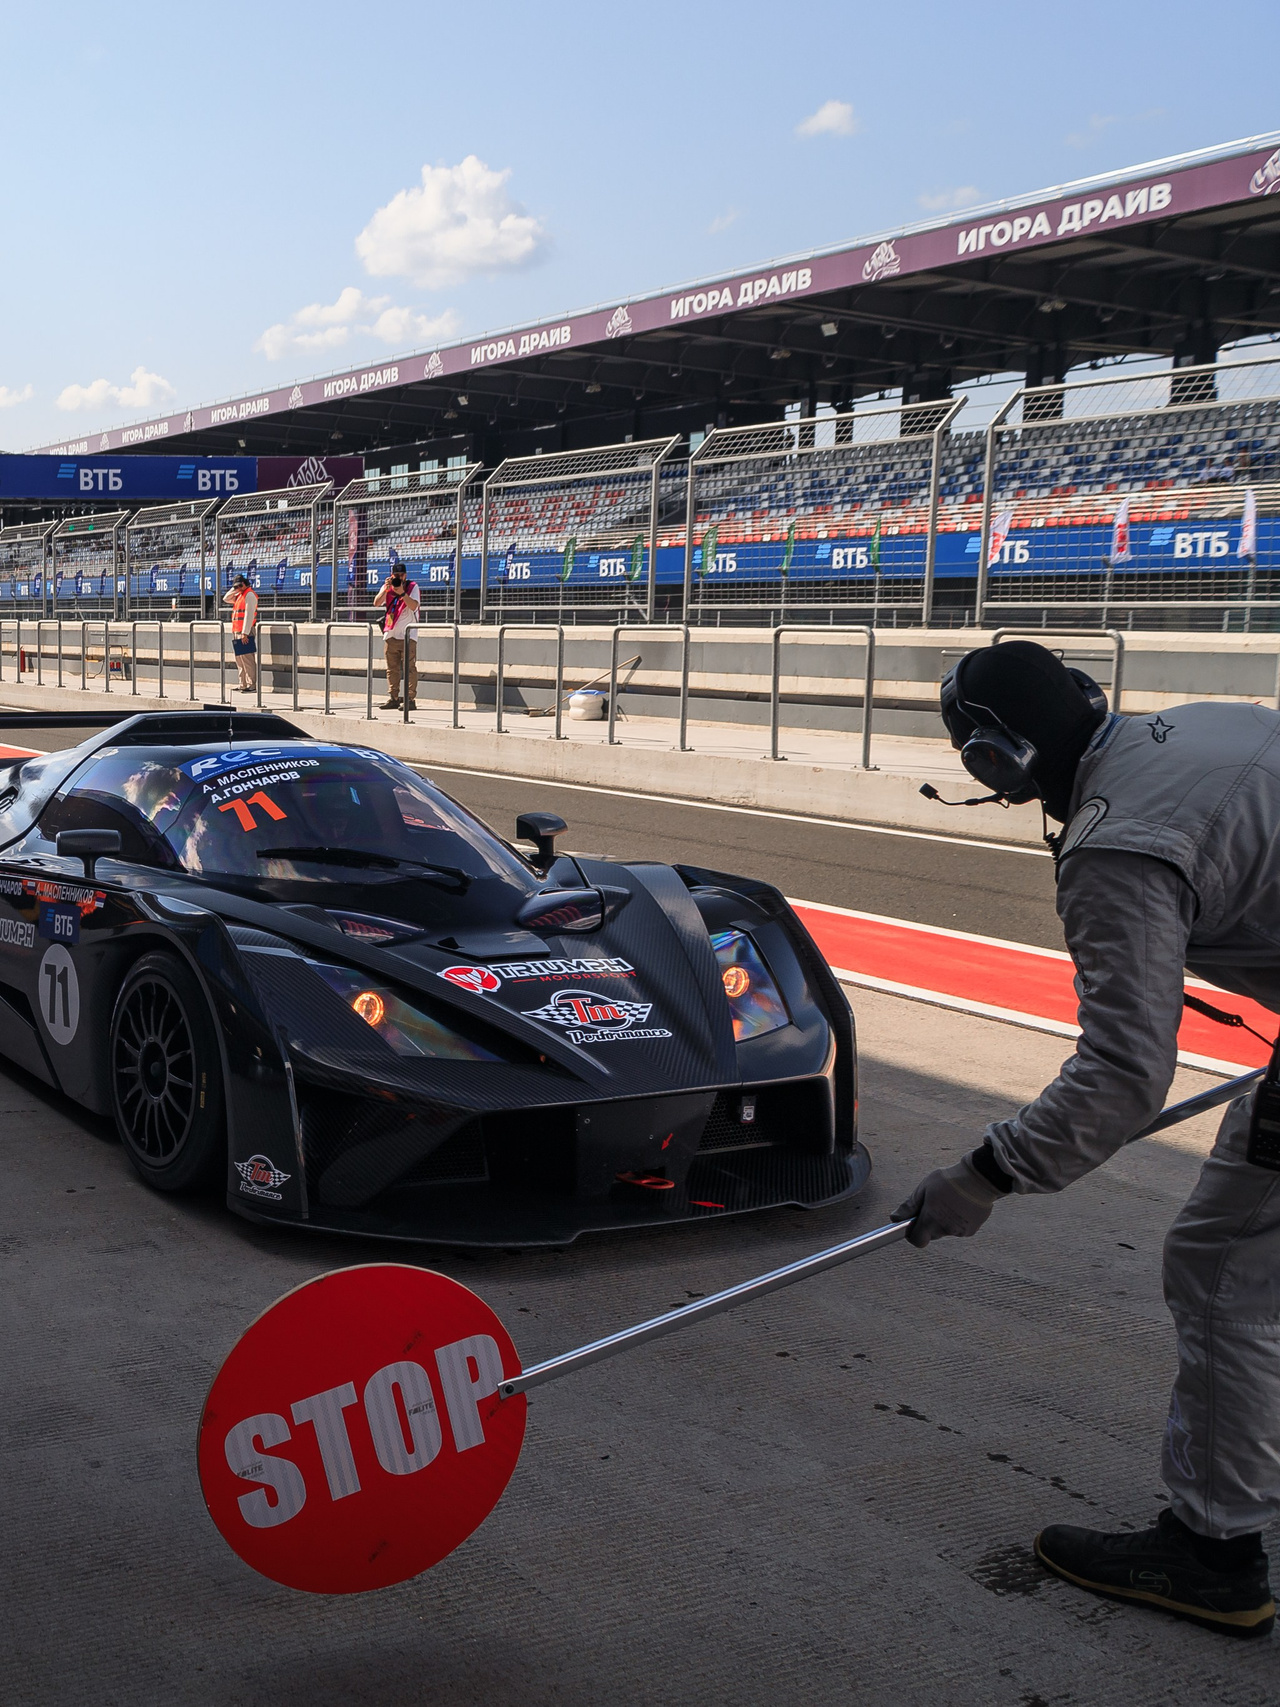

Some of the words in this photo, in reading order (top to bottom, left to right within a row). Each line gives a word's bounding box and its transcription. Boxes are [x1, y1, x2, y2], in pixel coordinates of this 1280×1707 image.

[957, 212, 1052, 256] ИГОРА
[1056, 182, 1172, 236] ДРАЙВ
[670, 290, 734, 320] ИГОРА
[736, 268, 812, 307] ДРАЙВ
[471, 339, 516, 364] ИГОРА
[518, 325, 571, 355] ДРАЙВ
[324, 376, 358, 398] ИГОРА
[360, 366, 399, 391] ДРАЙВ
[211, 406, 239, 423] ИГОРА
[122, 426, 143, 443] ИГОРА
[79, 469, 123, 491] ВТБ
[197, 469, 239, 491] ВТБ
[1173, 531, 1229, 558] ВТБ
[599, 558, 626, 577] ВТБ
[831, 547, 869, 569] ВТБ
[367, 569, 379, 584] ТБ
[430, 566, 450, 582] ВТБ
[508, 562, 531, 580] ВТБ
[156, 579, 168, 591] ВТБ
[202, 784, 216, 794] А.
[217, 759, 320, 787] МАСЛЕННИКОВ
[218, 791, 287, 832] 71
[35, 883, 43, 896] А.
[44, 883, 95, 905] МАСЛЕННИКОВ
[54, 914, 74, 937] ВТБ
[488, 957, 634, 979] TRIUMPH
[540, 971, 637, 983] MOTORSPORT
[45, 963, 70, 1028] 71
[556, 998, 627, 1024] Tm
[566, 1028, 673, 1045] Performance
[250, 1160, 272, 1184] Tm
[240, 1180, 282, 1200] Performance
[224, 1333, 505, 1529] STOP
